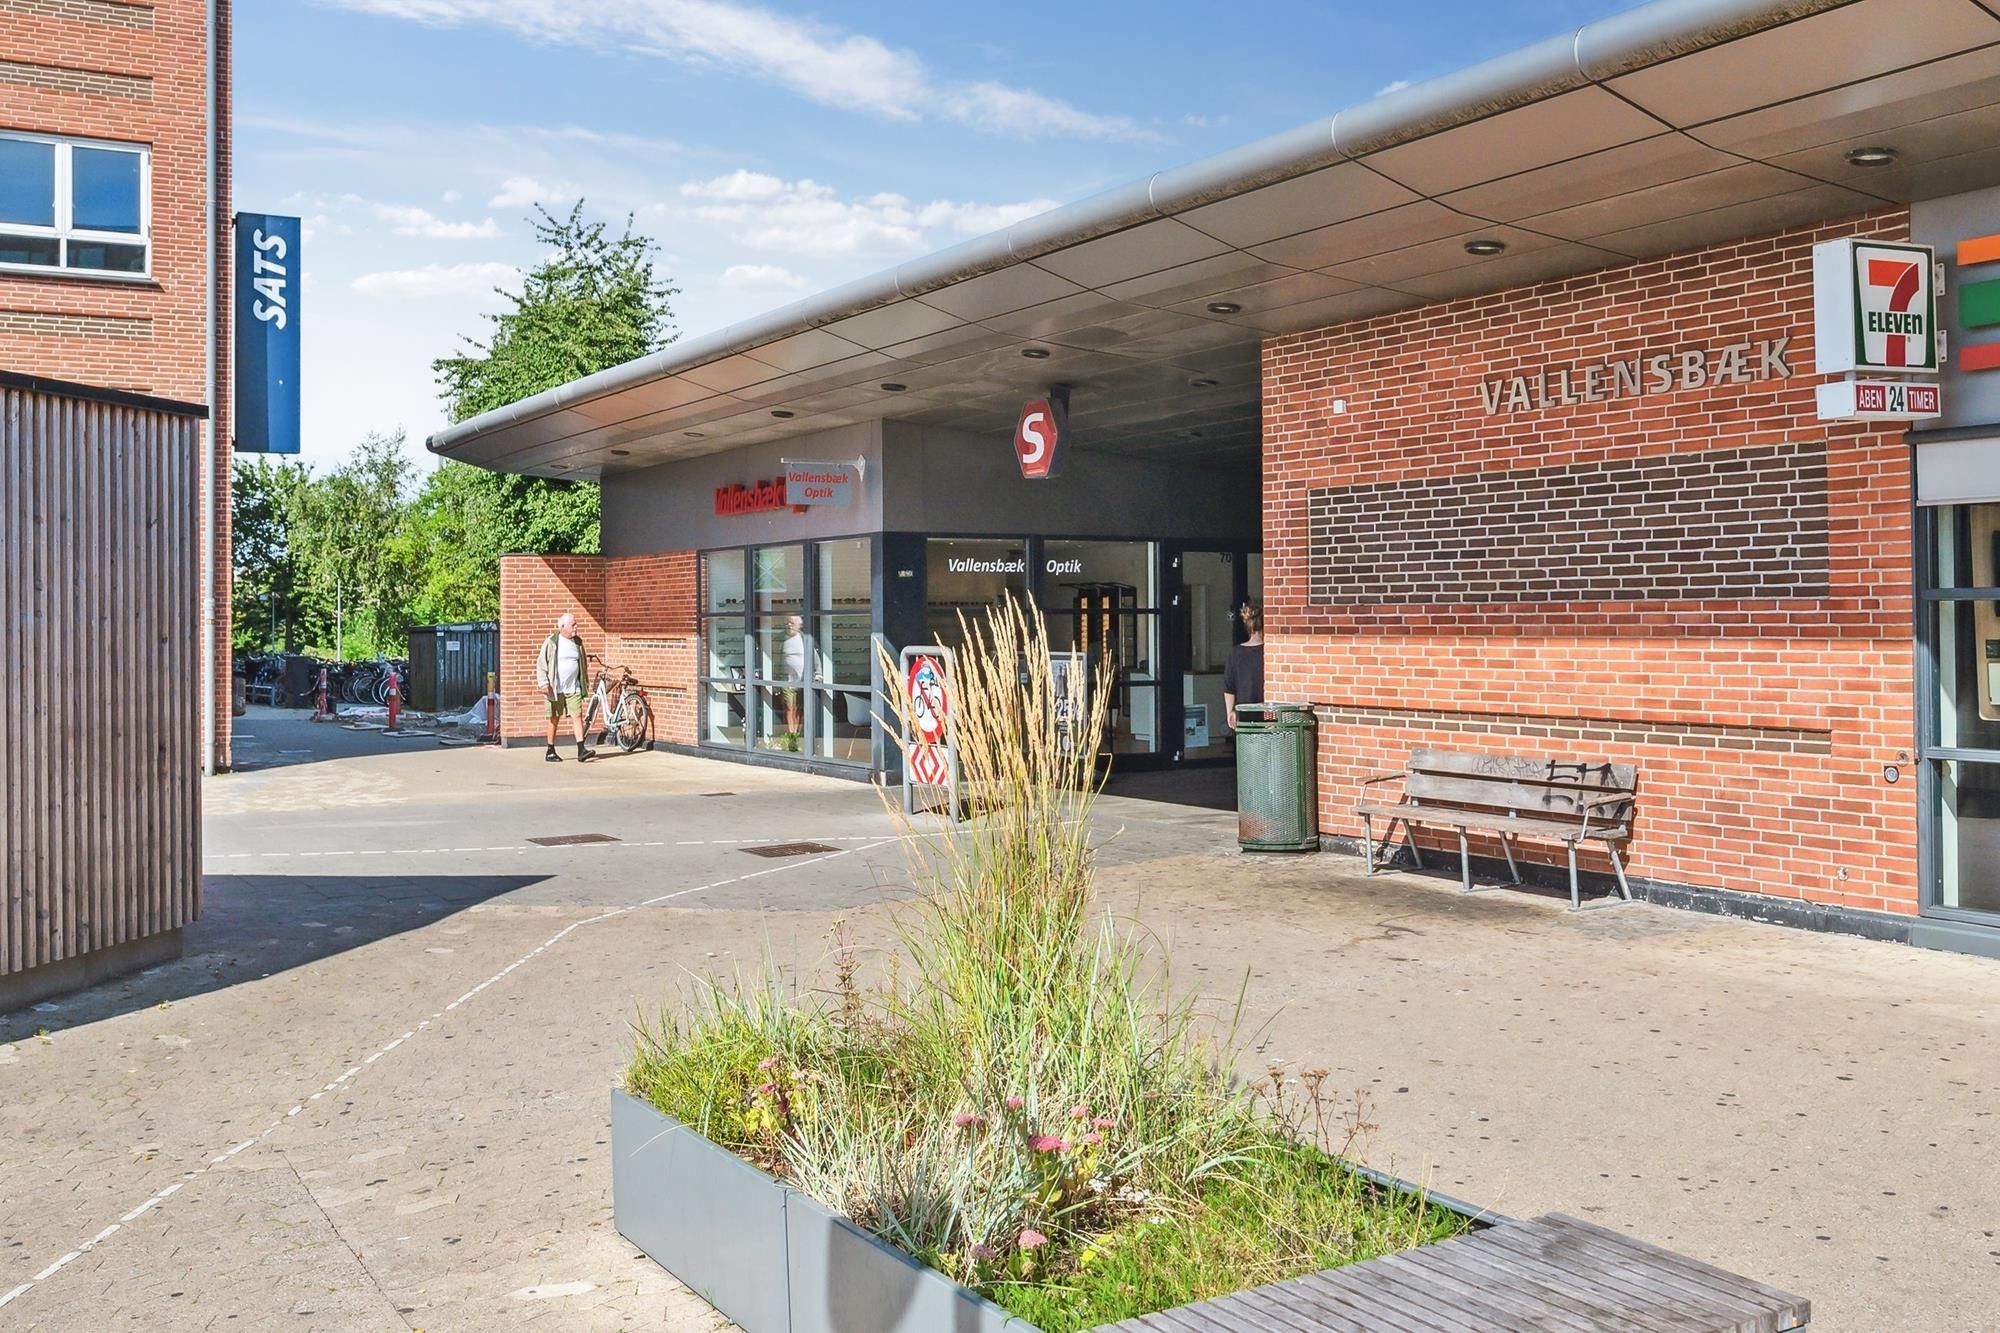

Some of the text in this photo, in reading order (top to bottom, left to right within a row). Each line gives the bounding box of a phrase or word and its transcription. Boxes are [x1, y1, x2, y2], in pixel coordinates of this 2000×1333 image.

[252, 228, 287, 330] SATS
[1868, 259, 1920, 367] 7
[1479, 336, 1792, 415] VALLENSBÆK
[1858, 386, 1935, 412] ÅBEN 24 TIMER
[1022, 412, 1045, 464] S
[788, 471, 849, 484] Vallensbæk
[804, 487, 833, 499] Optik
[948, 558, 1082, 576] Vallensbæk Optik
[1219, 552, 1232, 563] 70
